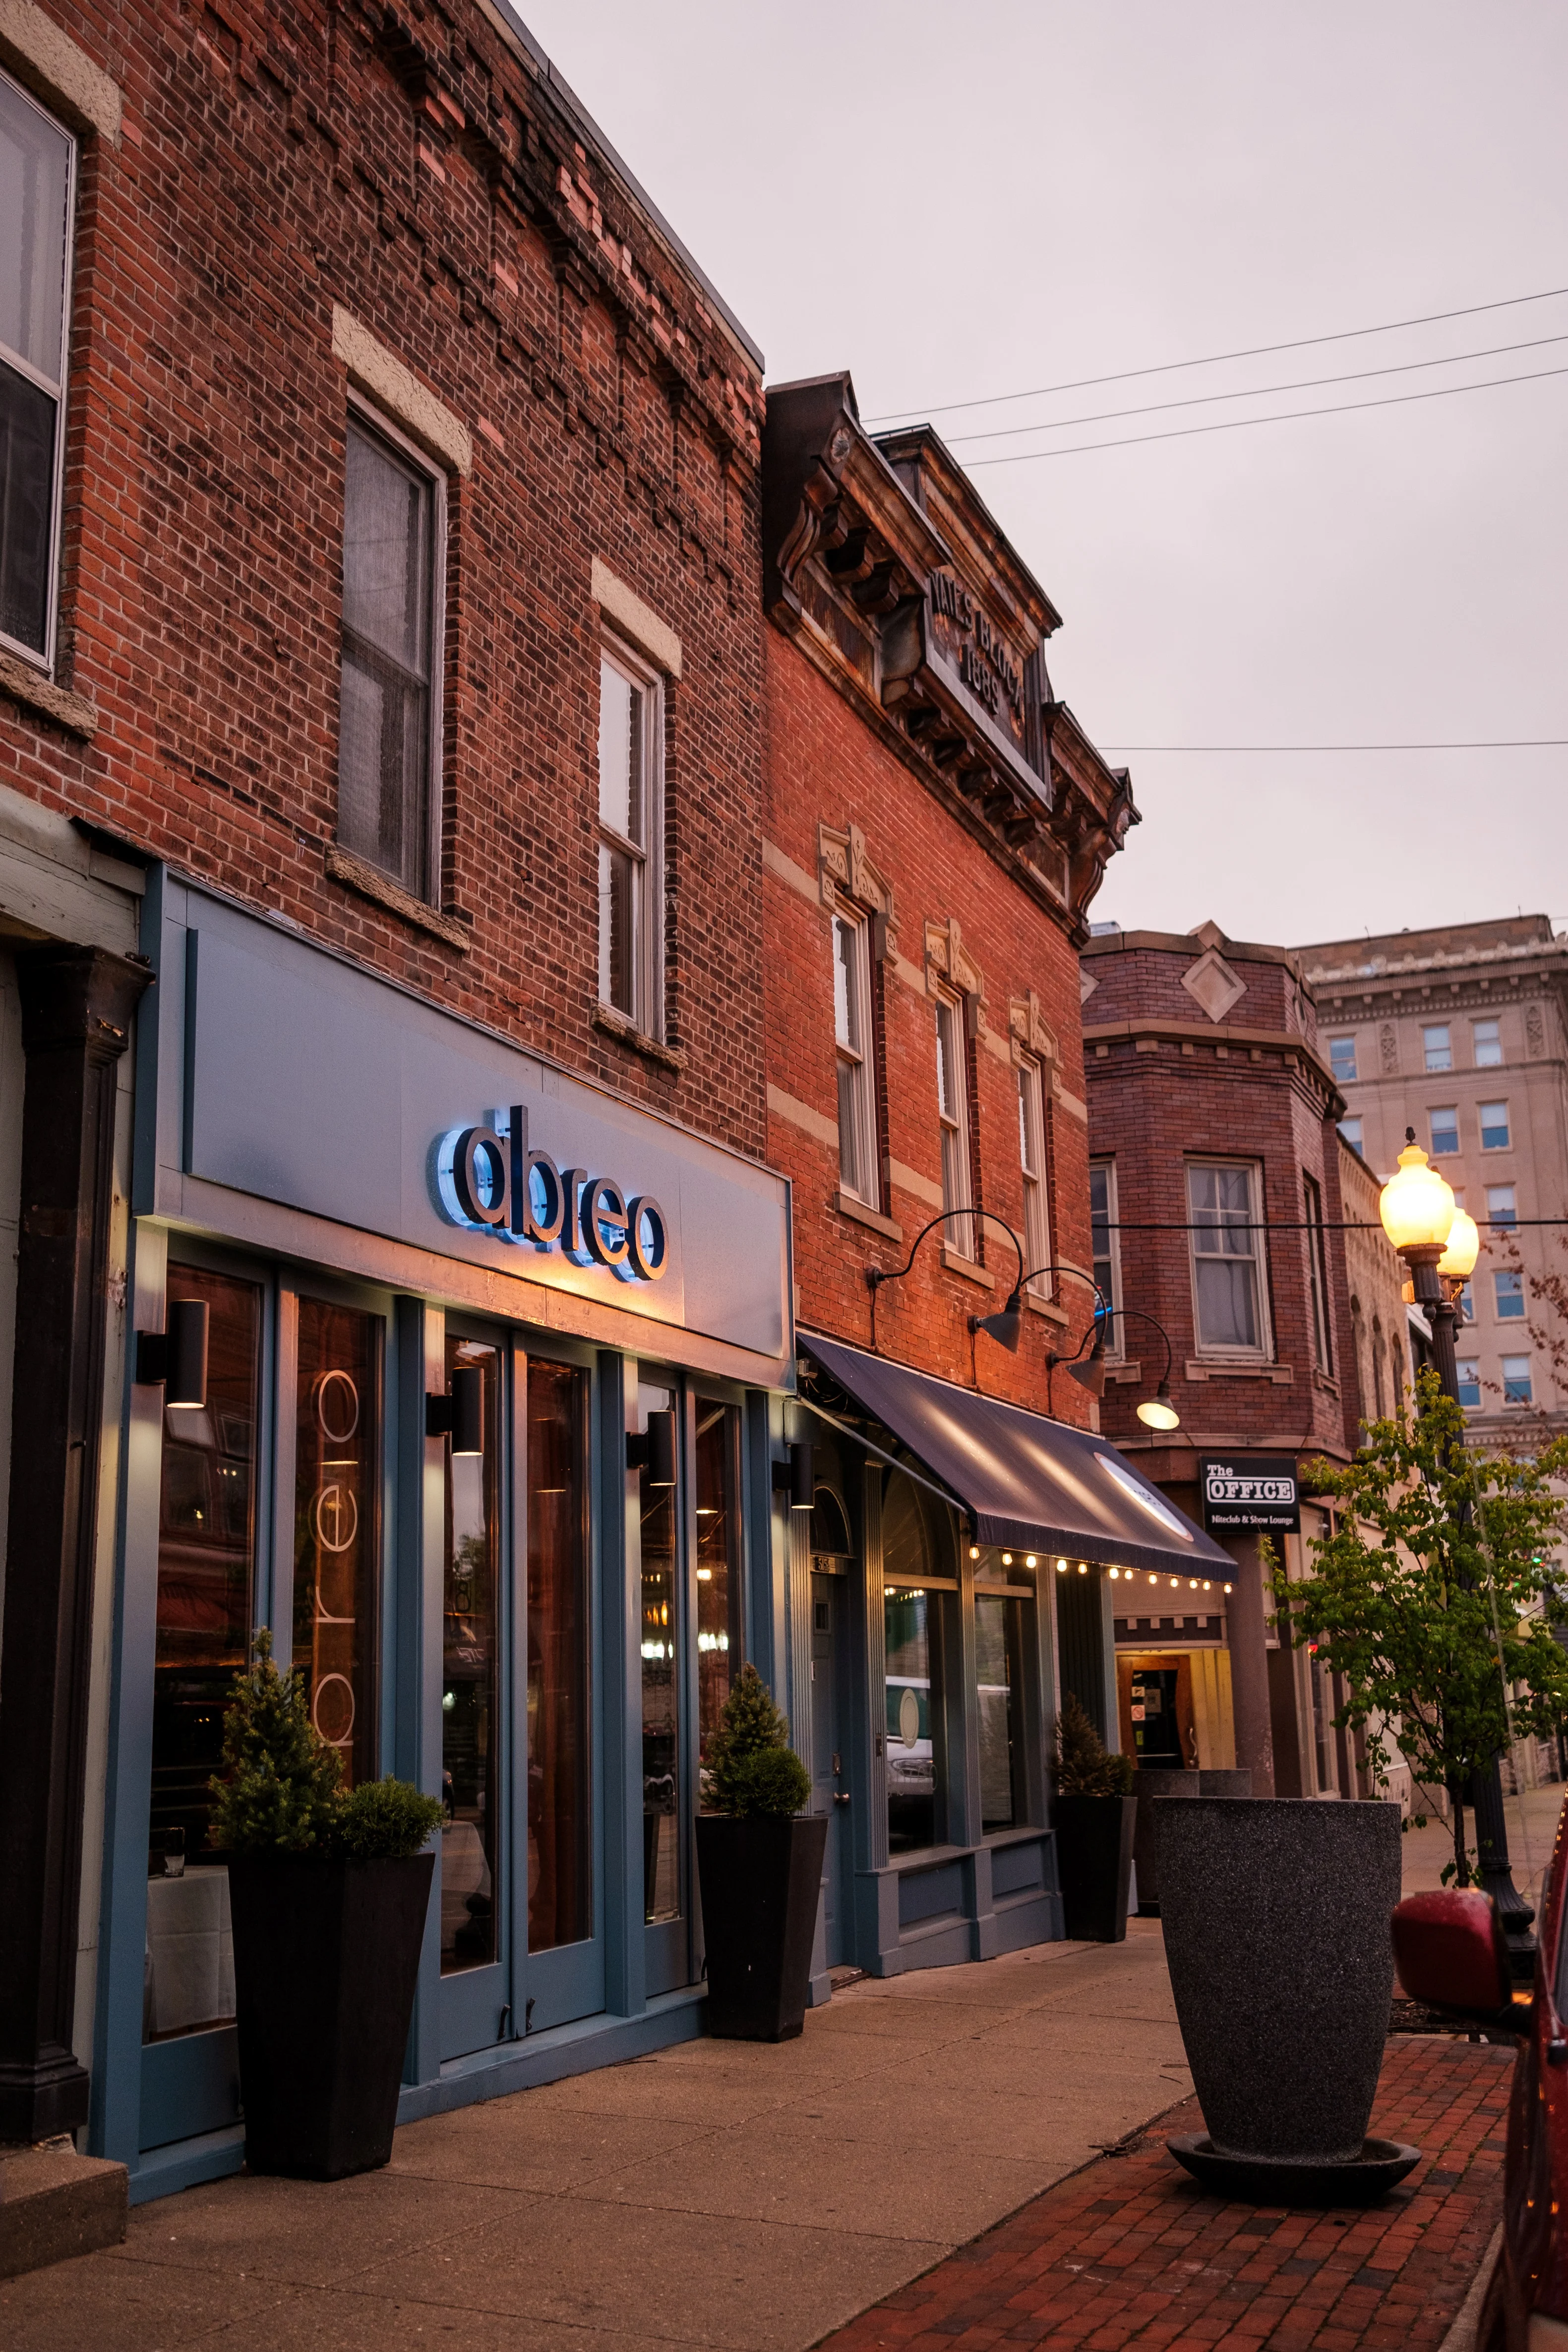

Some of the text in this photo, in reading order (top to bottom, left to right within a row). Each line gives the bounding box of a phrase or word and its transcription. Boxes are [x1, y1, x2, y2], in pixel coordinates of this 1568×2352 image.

[932, 572, 1024, 714] YATES BLOCK
[962, 644, 999, 715] 1889
[453, 1105, 668, 1281] abreo
[1207, 1465, 1233, 1476] The
[1211, 1481, 1291, 1499] OFFICE
[1211, 1515, 1293, 1526] Niteclub & Show Lounge
